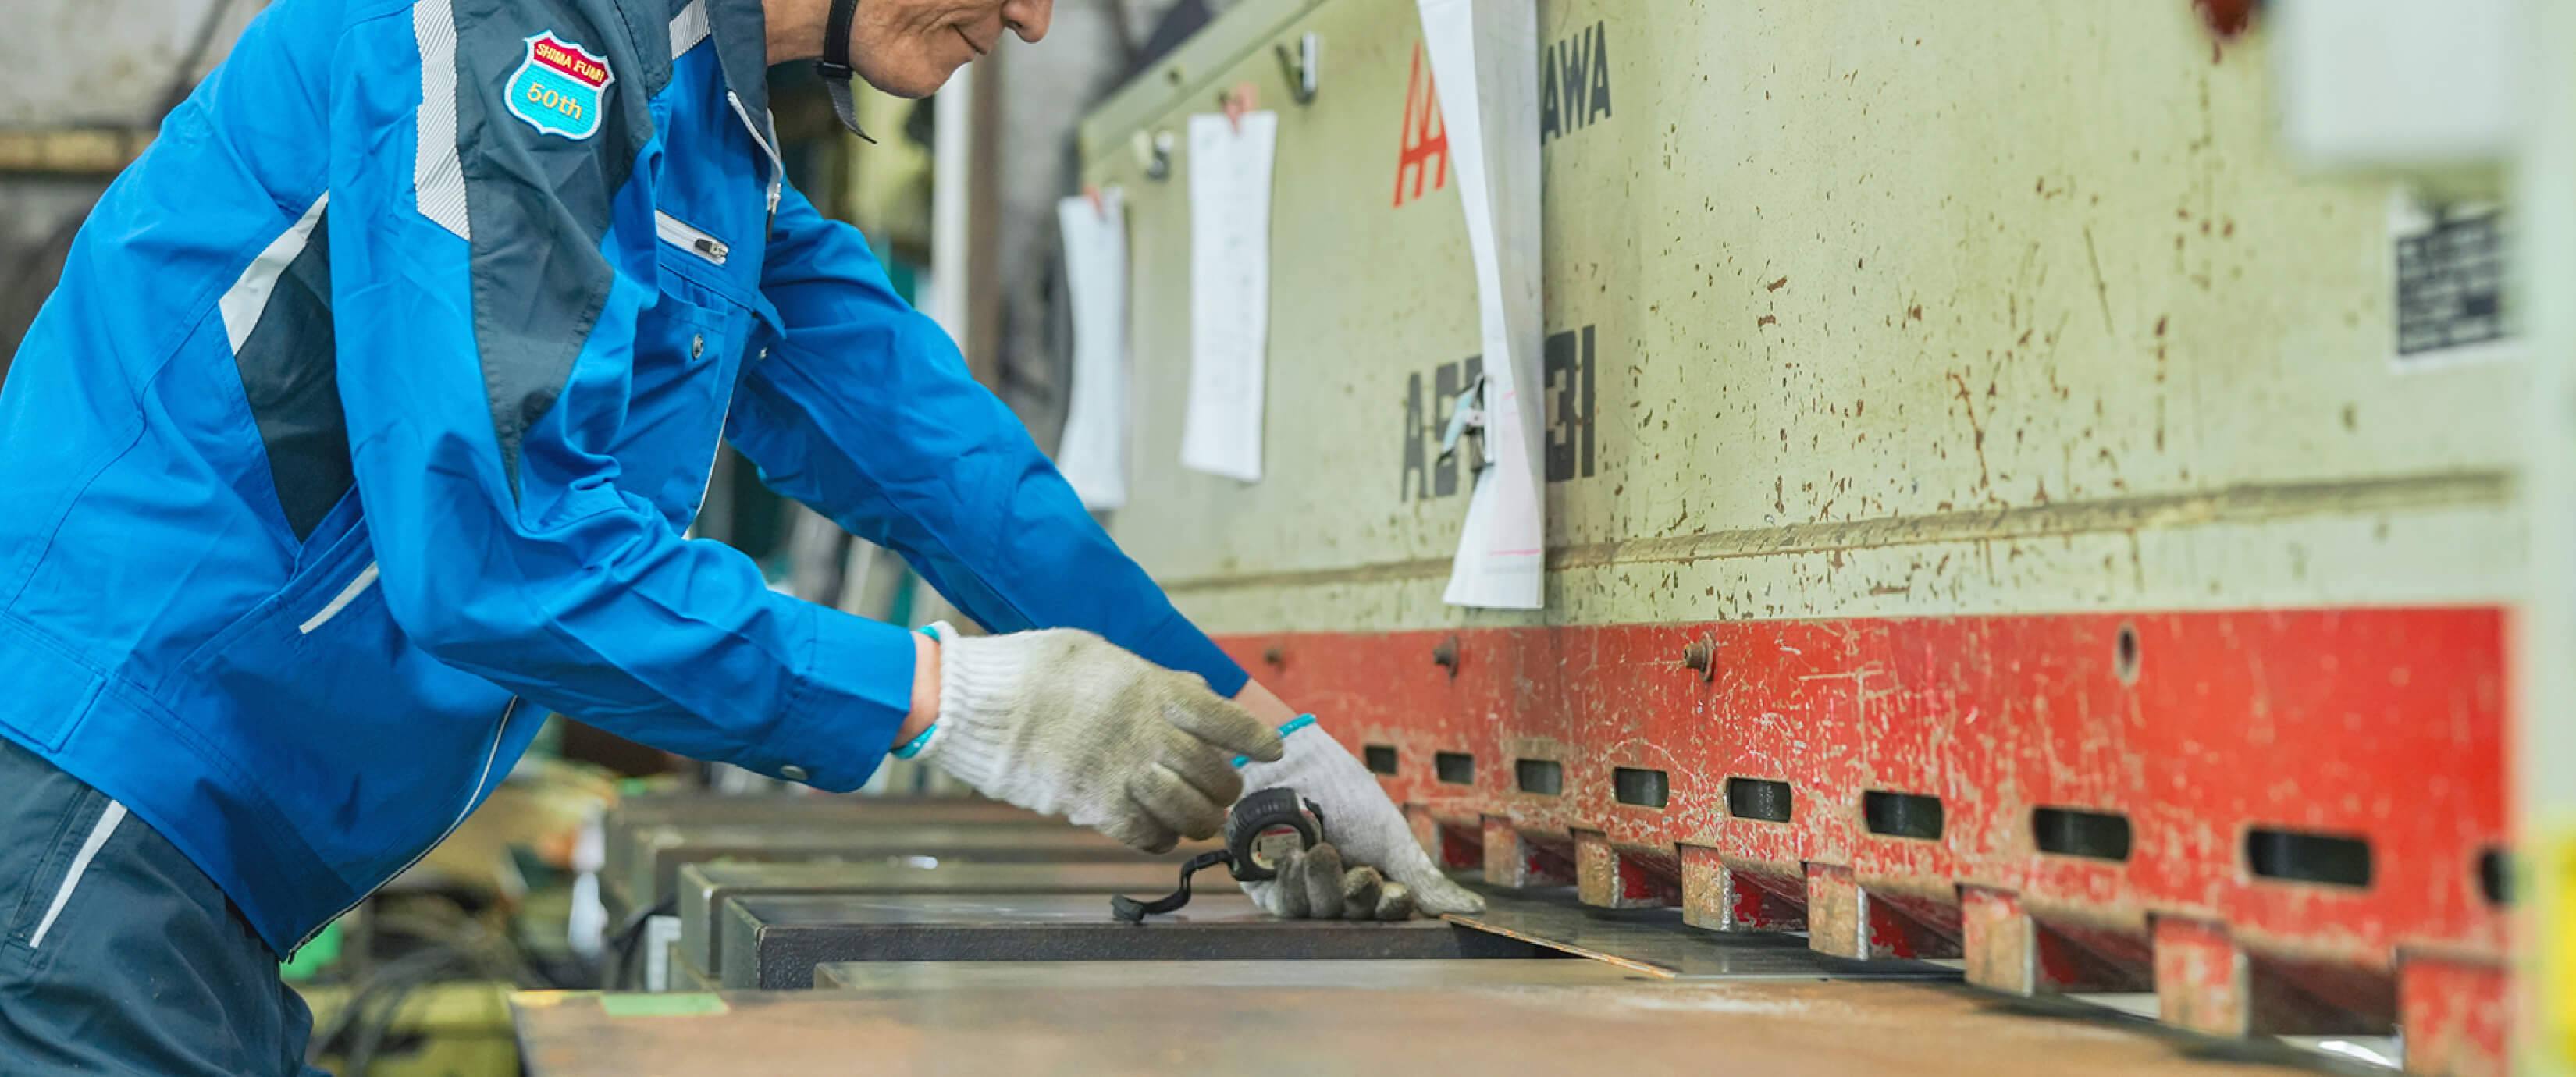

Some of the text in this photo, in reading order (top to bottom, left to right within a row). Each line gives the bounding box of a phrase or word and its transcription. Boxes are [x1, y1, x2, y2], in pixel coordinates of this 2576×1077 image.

[536, 43, 605, 83] SHIMA FUMI
[527, 82, 582, 120] 50th
[1540, 20, 1611, 148] AWA
